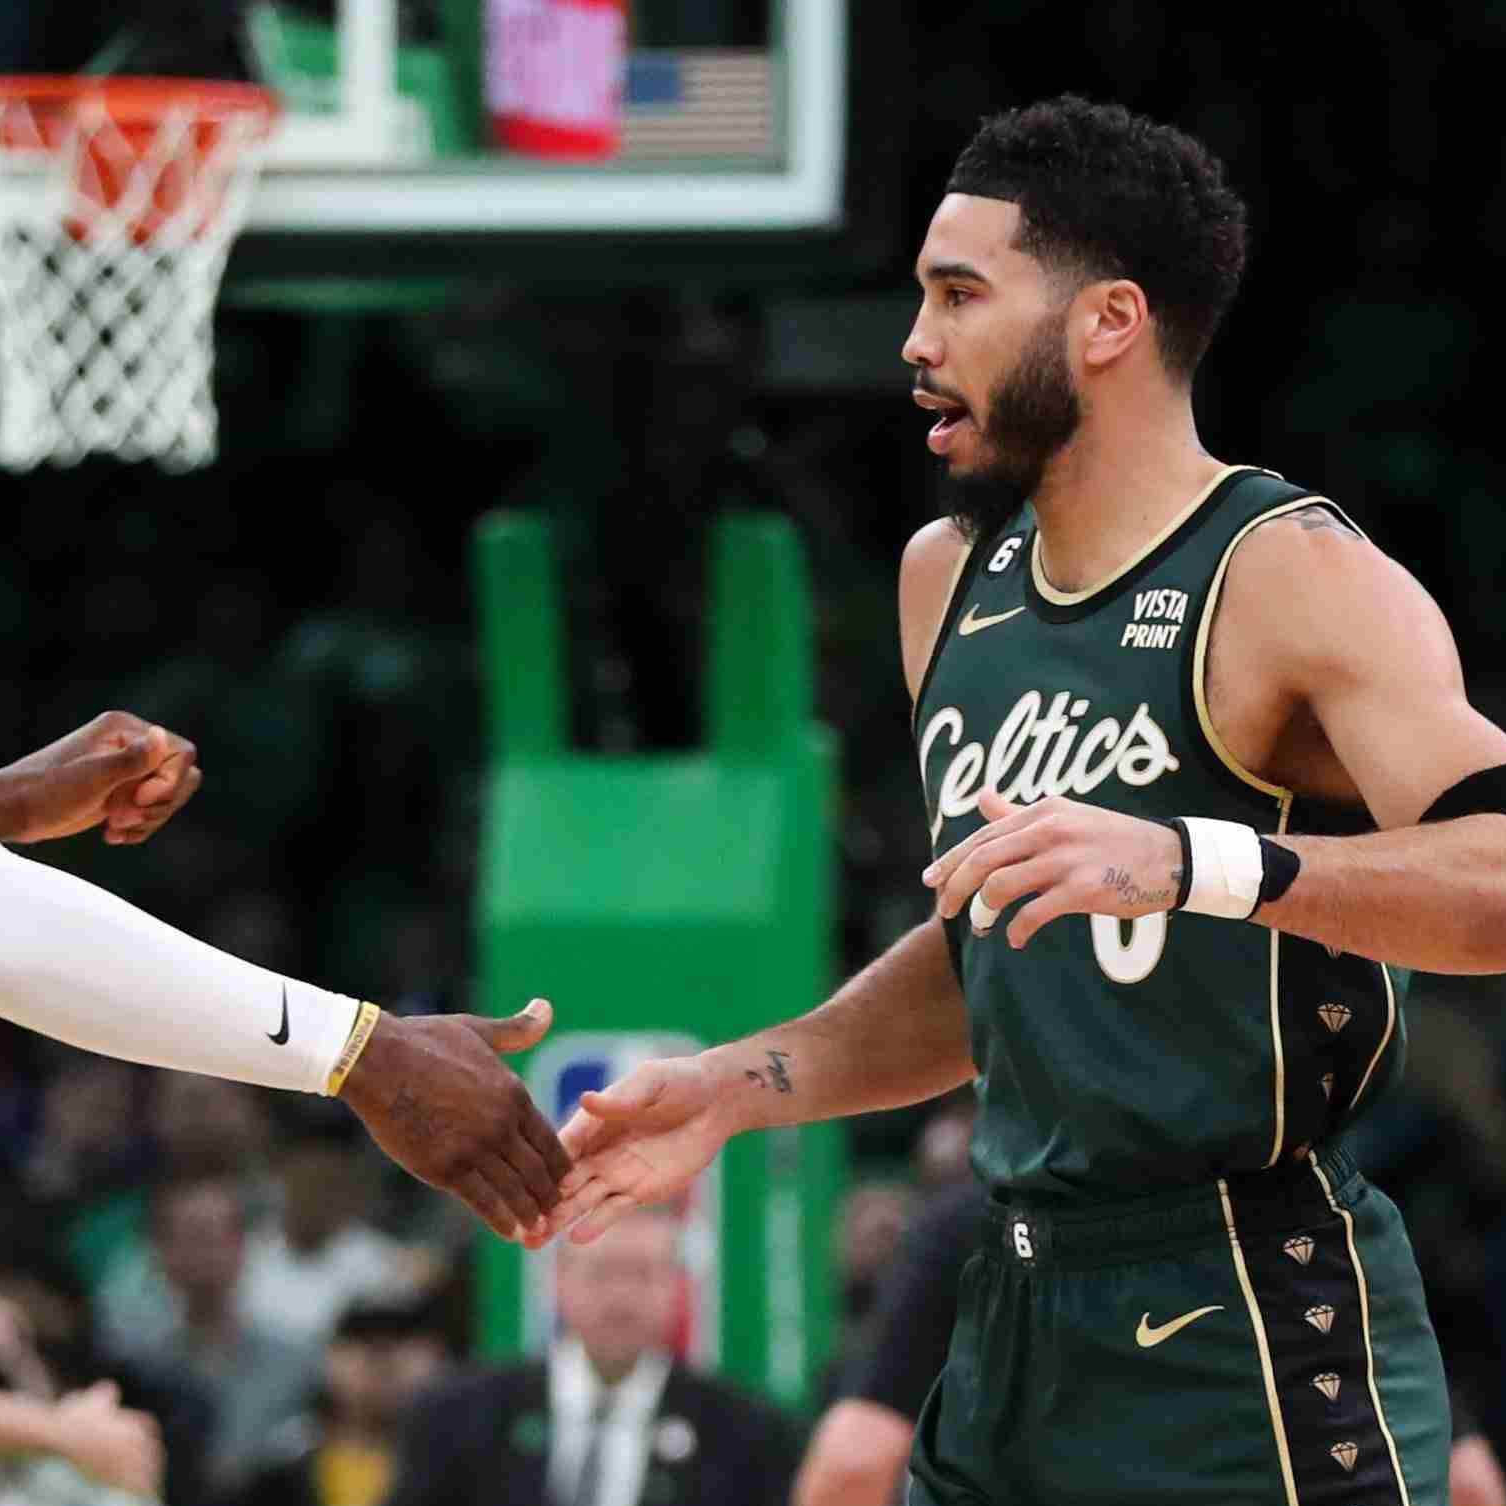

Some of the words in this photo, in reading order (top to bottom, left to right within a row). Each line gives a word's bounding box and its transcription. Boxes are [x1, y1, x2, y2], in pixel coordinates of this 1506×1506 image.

[987, 537, 1022, 572] 6
[1133, 588, 1189, 624] VISTA
[1120, 623, 1182, 649] PRINT
[920, 690, 1180, 817] Celtics
[1013, 1222, 1034, 1258] 6
